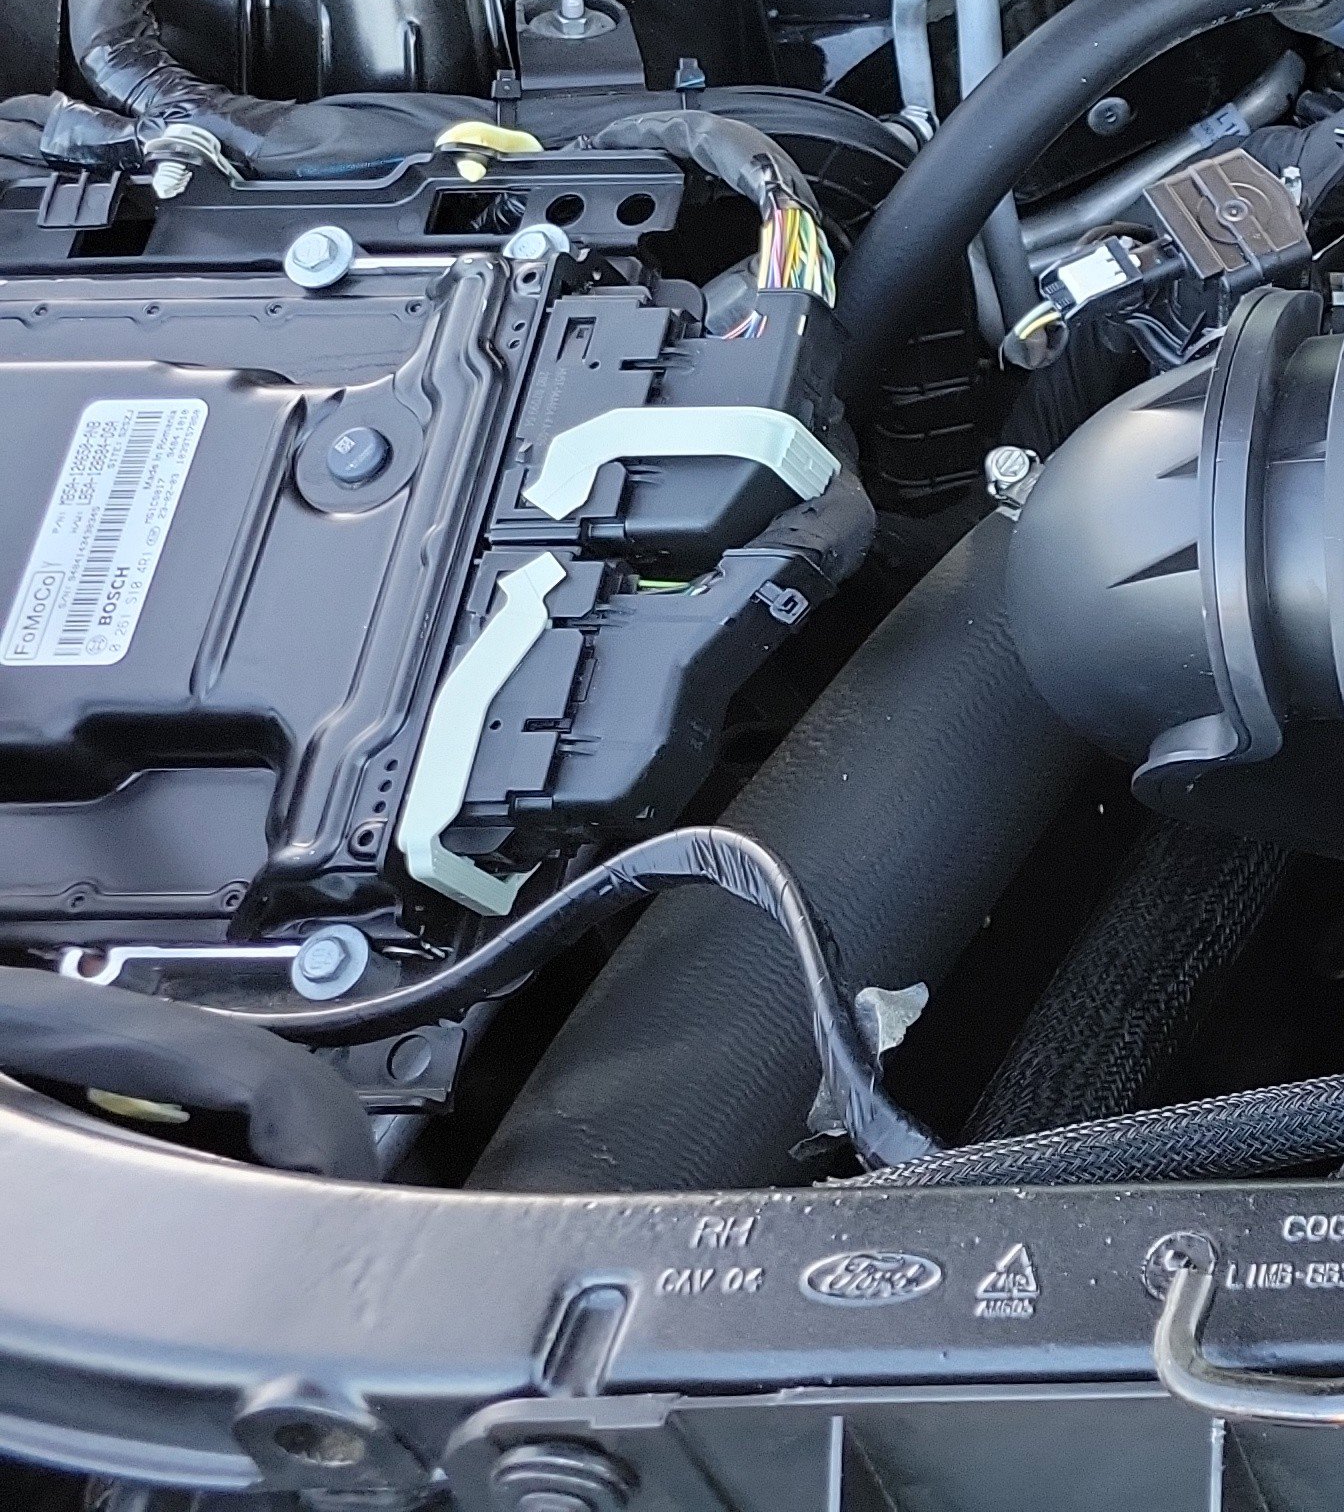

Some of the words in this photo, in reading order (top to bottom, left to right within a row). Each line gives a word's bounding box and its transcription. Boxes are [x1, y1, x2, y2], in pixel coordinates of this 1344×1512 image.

[14, 575, 56, 655] FoMoCo
[97, 566, 131, 626] BOSCH
[690, 1216, 758, 1249] RH
[654, 1267, 715, 1295] CAV
[820, 1251, 926, 1299] Ford
